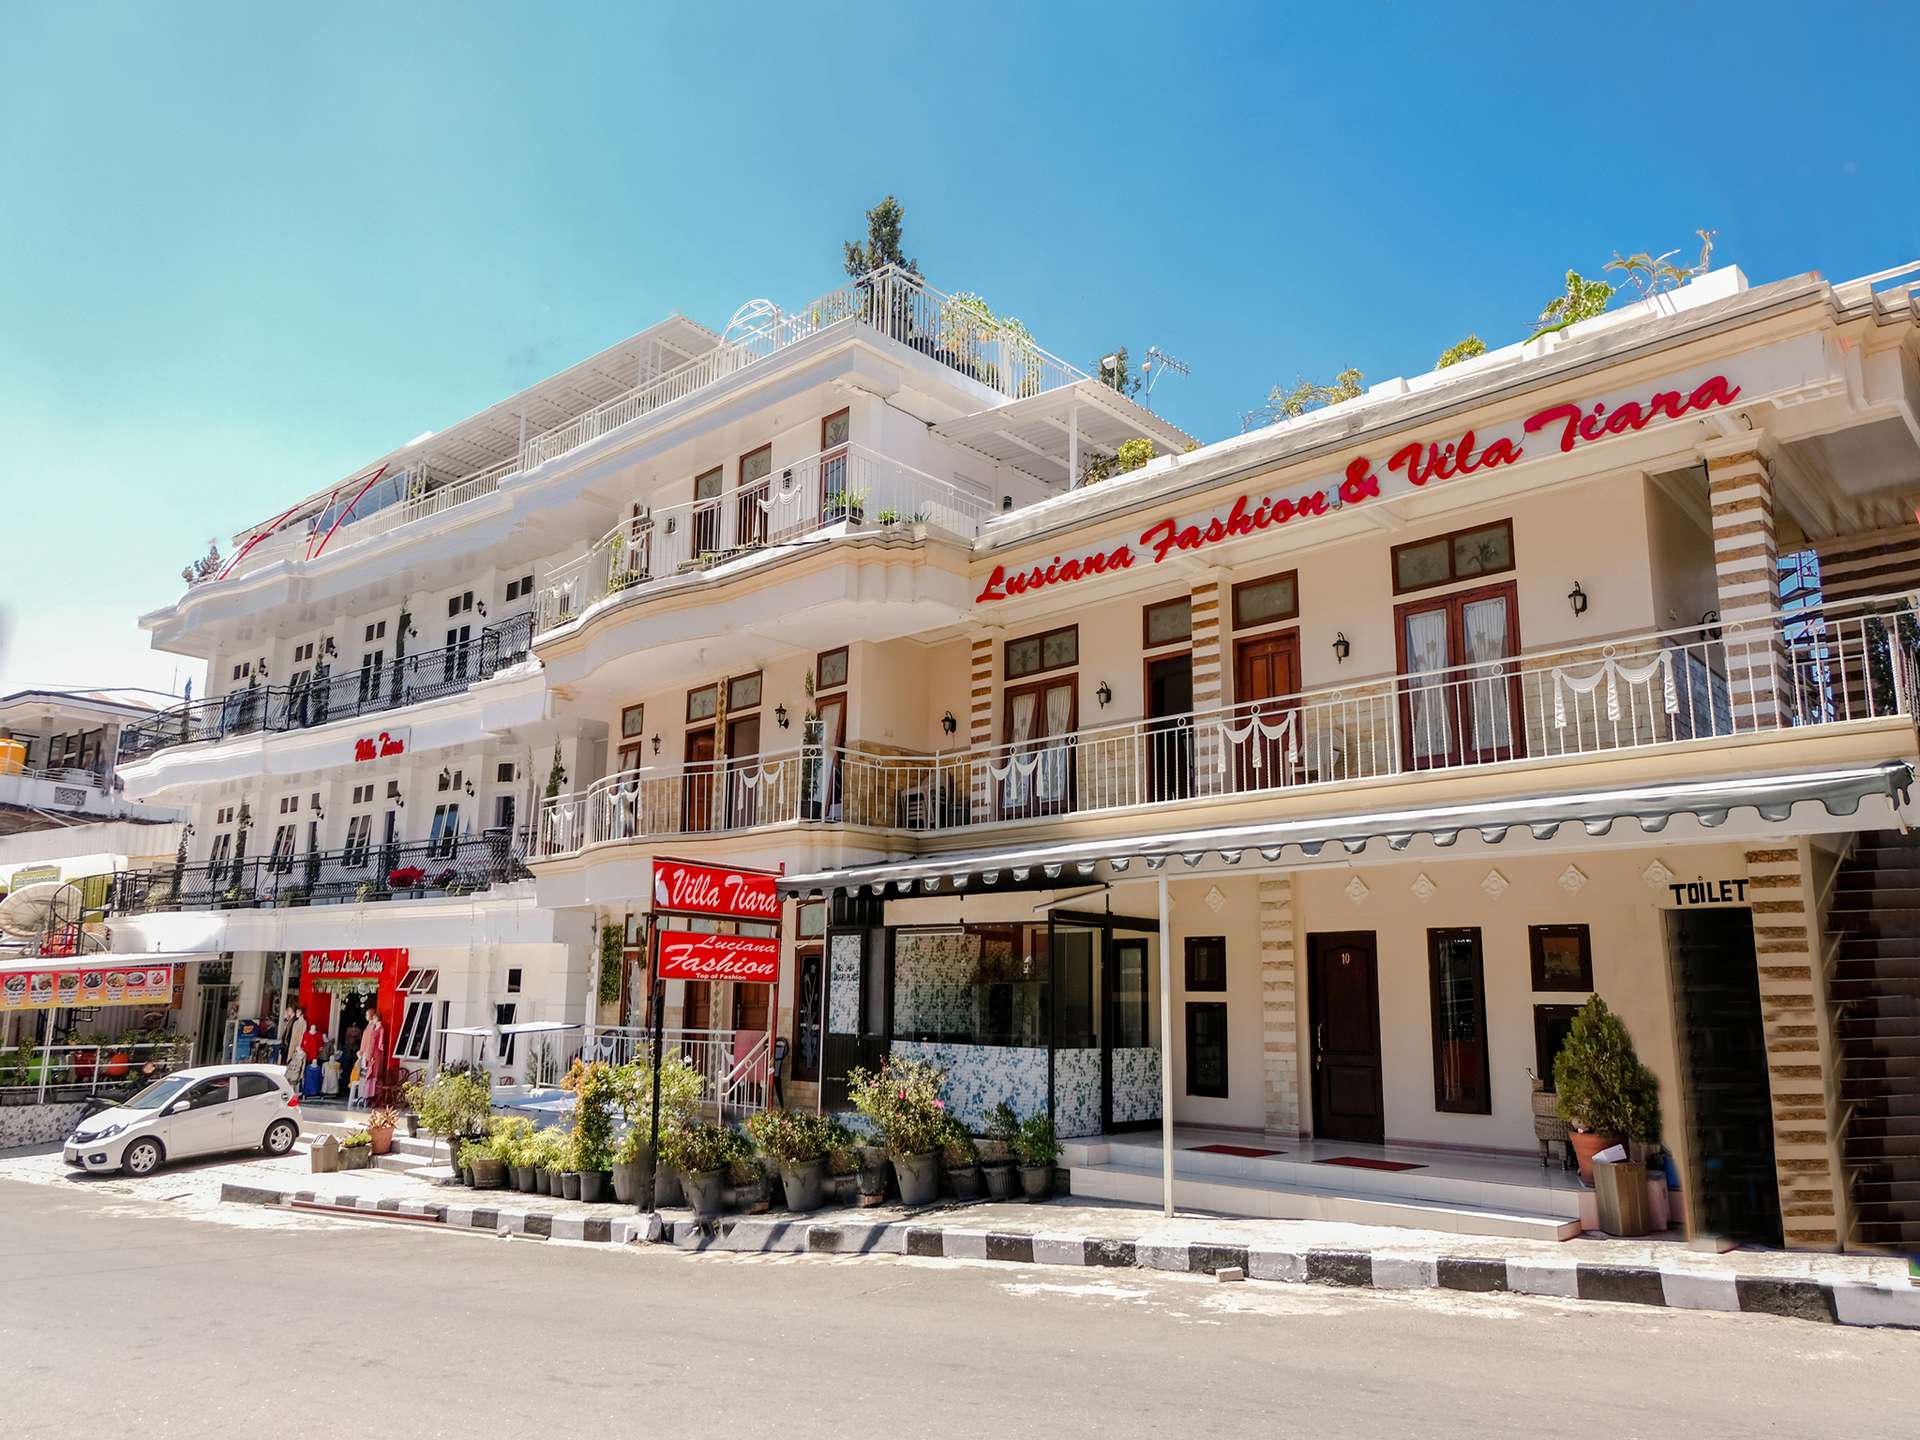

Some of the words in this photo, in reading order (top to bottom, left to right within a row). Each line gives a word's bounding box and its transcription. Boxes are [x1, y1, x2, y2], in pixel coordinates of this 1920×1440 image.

[975, 546, 1136, 604] Lusiana
[1139, 491, 1330, 564] Fashion
[1339, 456, 1381, 504] &
[1388, 430, 1524, 486] Vila
[1523, 375, 1742, 453] Tiara
[672, 868, 721, 908] Villa
[724, 874, 778, 913] Tiara
[694, 935, 777, 953] Luciana
[664, 943, 775, 975] Fashion
[1341, 952, 1350, 965] 10
[696, 972, 709, 980] Top
